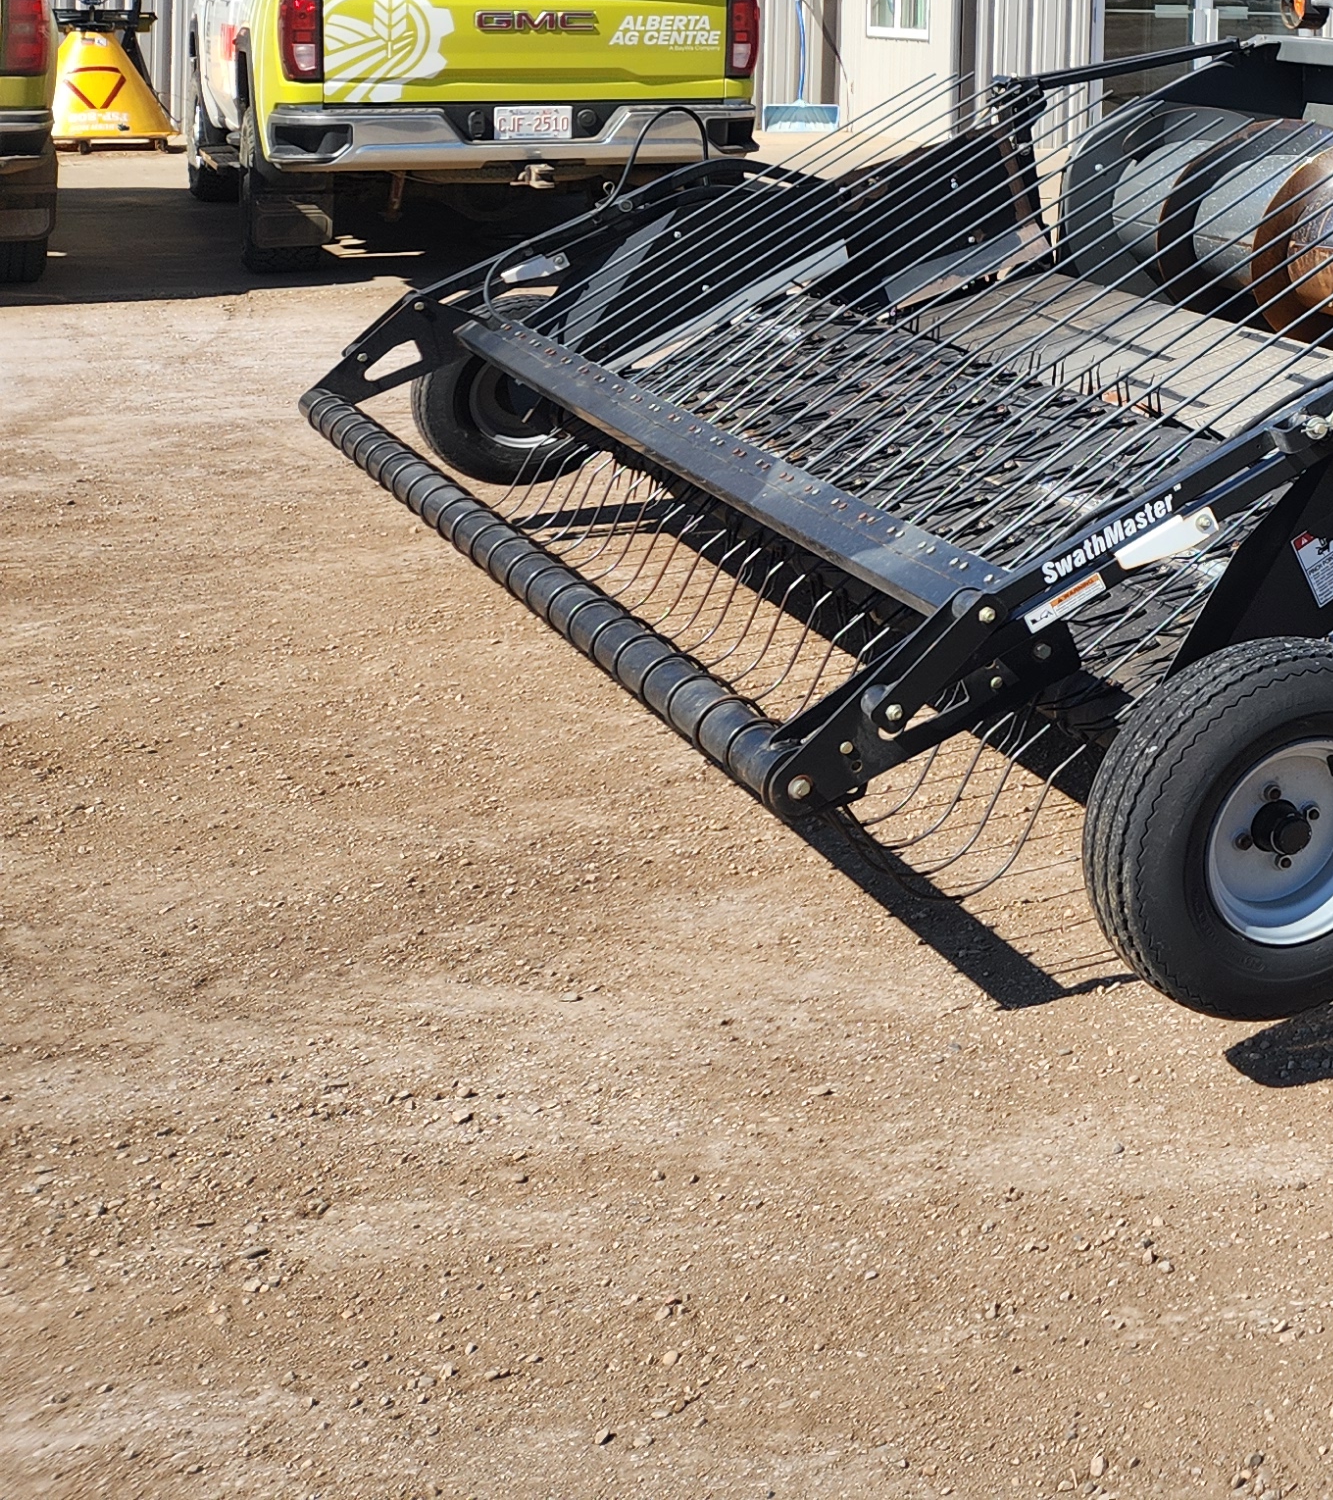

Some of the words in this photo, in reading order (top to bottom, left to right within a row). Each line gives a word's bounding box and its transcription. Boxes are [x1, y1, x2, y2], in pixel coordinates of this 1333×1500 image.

[475, 10, 597, 32] GMC
[618, 15, 711, 31] ALBERTA
[608, 31, 640, 46] AG
[643, 31, 721, 46] CENTRE
[498, 116, 569, 133] CJF-2510
[1041, 493, 1174, 584] SwathMaster
